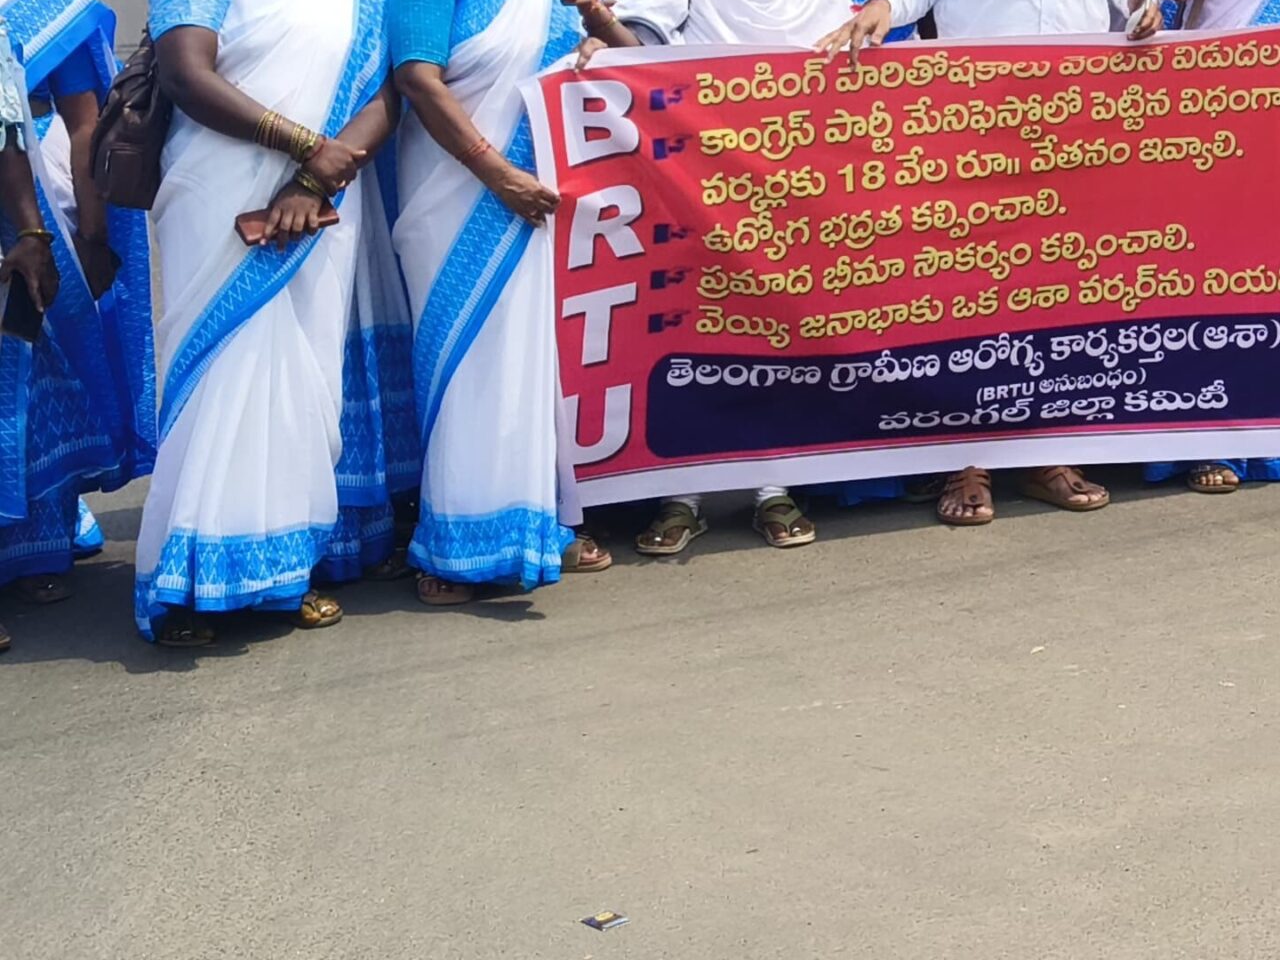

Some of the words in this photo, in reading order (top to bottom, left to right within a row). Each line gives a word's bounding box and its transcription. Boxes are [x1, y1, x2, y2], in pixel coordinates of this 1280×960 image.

[696, 59, 827, 106] పెండింగ్
[700, 109, 817, 161] కాంగ్రెస్
[825, 100, 895, 153] పార్టీ
[1090, 83, 1171, 131] పెట్టిన
[838, 161, 886, 192] 18
[895, 146, 948, 185] వేల
[1030, 134, 1131, 173] వేతనం
[702, 215, 811, 260] ఉద్యోగ
[820, 205, 902, 249] భద్రత
[560, 79, 645, 466] BRTU
[697, 262, 813, 302] ప్రమాద
[822, 255, 903, 301] భీమా
[912, 239, 1032, 278] సౌకర్యం
[696, 304, 790, 349] వెయ్యి
[800, 294, 944, 340] జనాభాకు
[952, 286, 999, 316] ఒక
[1007, 279, 1071, 310] ఆశా
[666, 359, 821, 386] తెలంగాణ
[829, 353, 939, 392] గ్రామీణ
[948, 333, 1045, 376] ఆరోగ్య
[878, 398, 1032, 431] వరంగల్
[1040, 394, 1115, 421] జిల్లా
[1123, 379, 1228, 413] కమిటీ
[976, 382, 1035, 407] (BRTU
